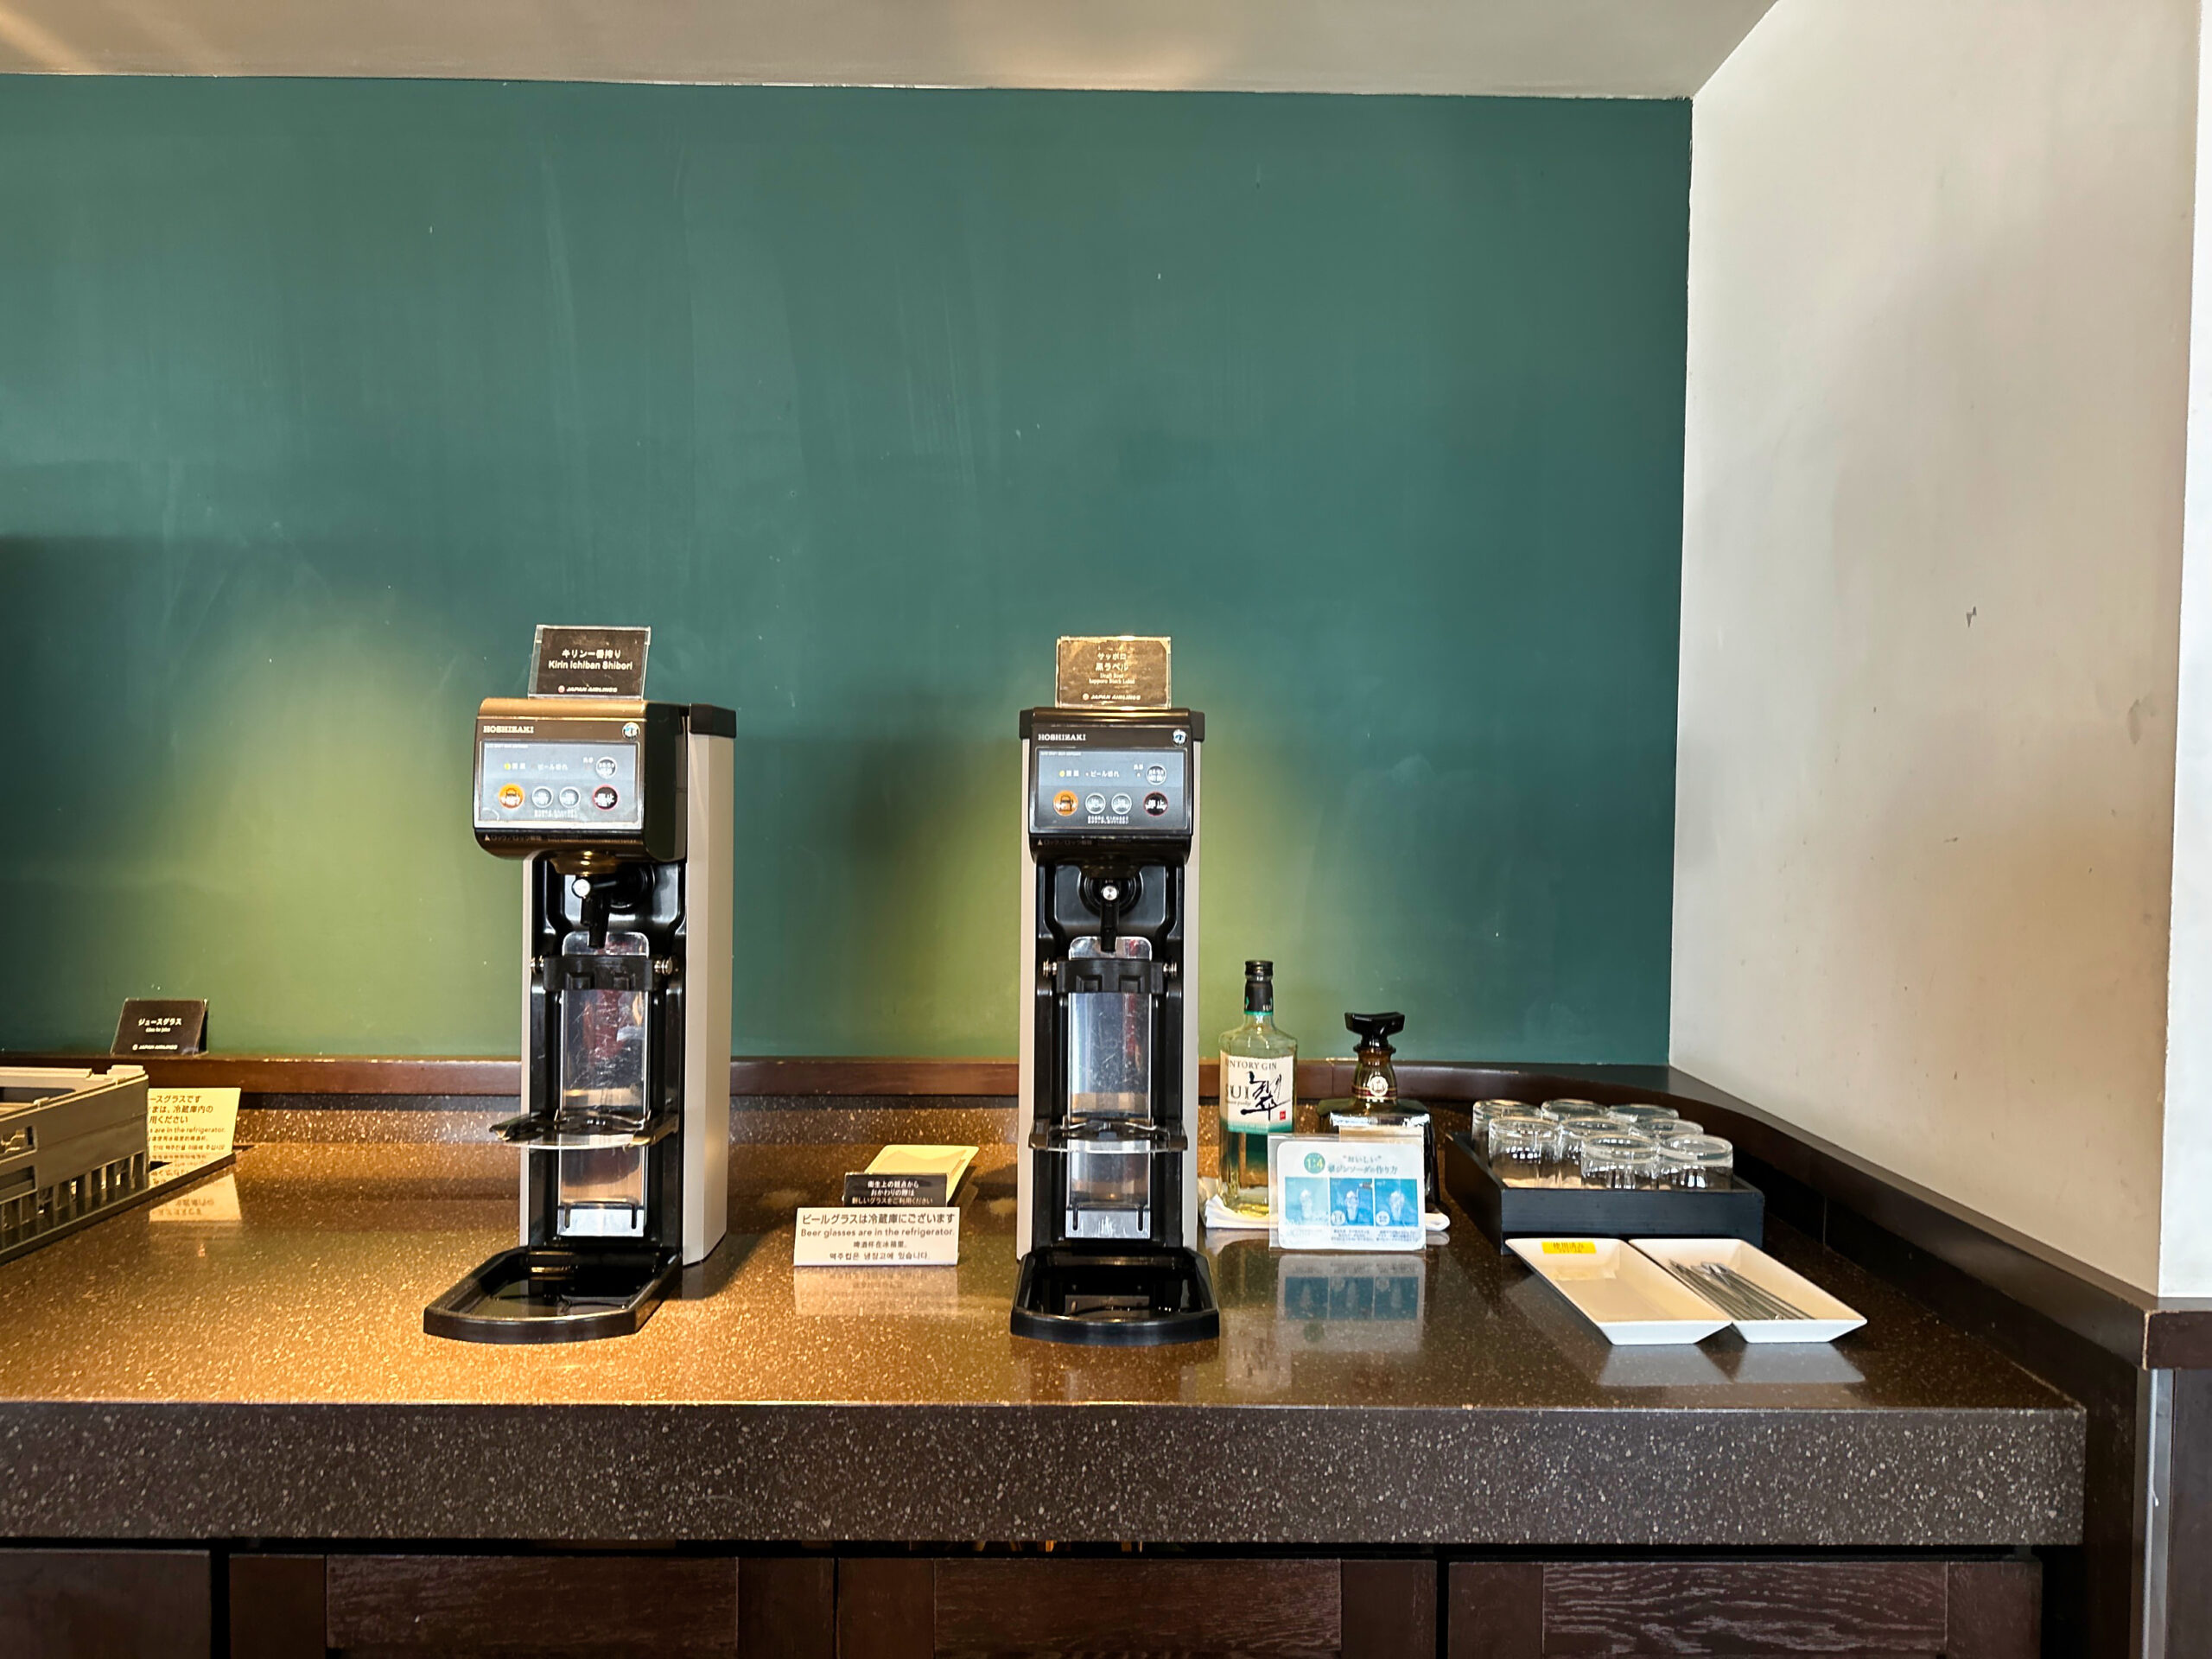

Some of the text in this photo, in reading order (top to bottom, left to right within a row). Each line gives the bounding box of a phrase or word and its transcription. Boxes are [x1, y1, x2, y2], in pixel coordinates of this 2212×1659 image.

[549, 660, 632, 670] Kirin Ichiban Shibori
[1096, 662, 1128, 671] 黒ラベル
[483, 725, 534, 734] HOSHIZAKI
[1262, 1062, 1277, 1071] GIN
[149, 1105, 213, 1114] まは、冷蔵庫内の
[803, 1213, 955, 1224] ビールグラスは冷蔵庫にございます
[823, 1228, 855, 1238] glasses
[874, 1227, 882, 1236] in
[885, 1227, 899, 1236] the
[901, 1227, 955, 1238] refrigerator.
